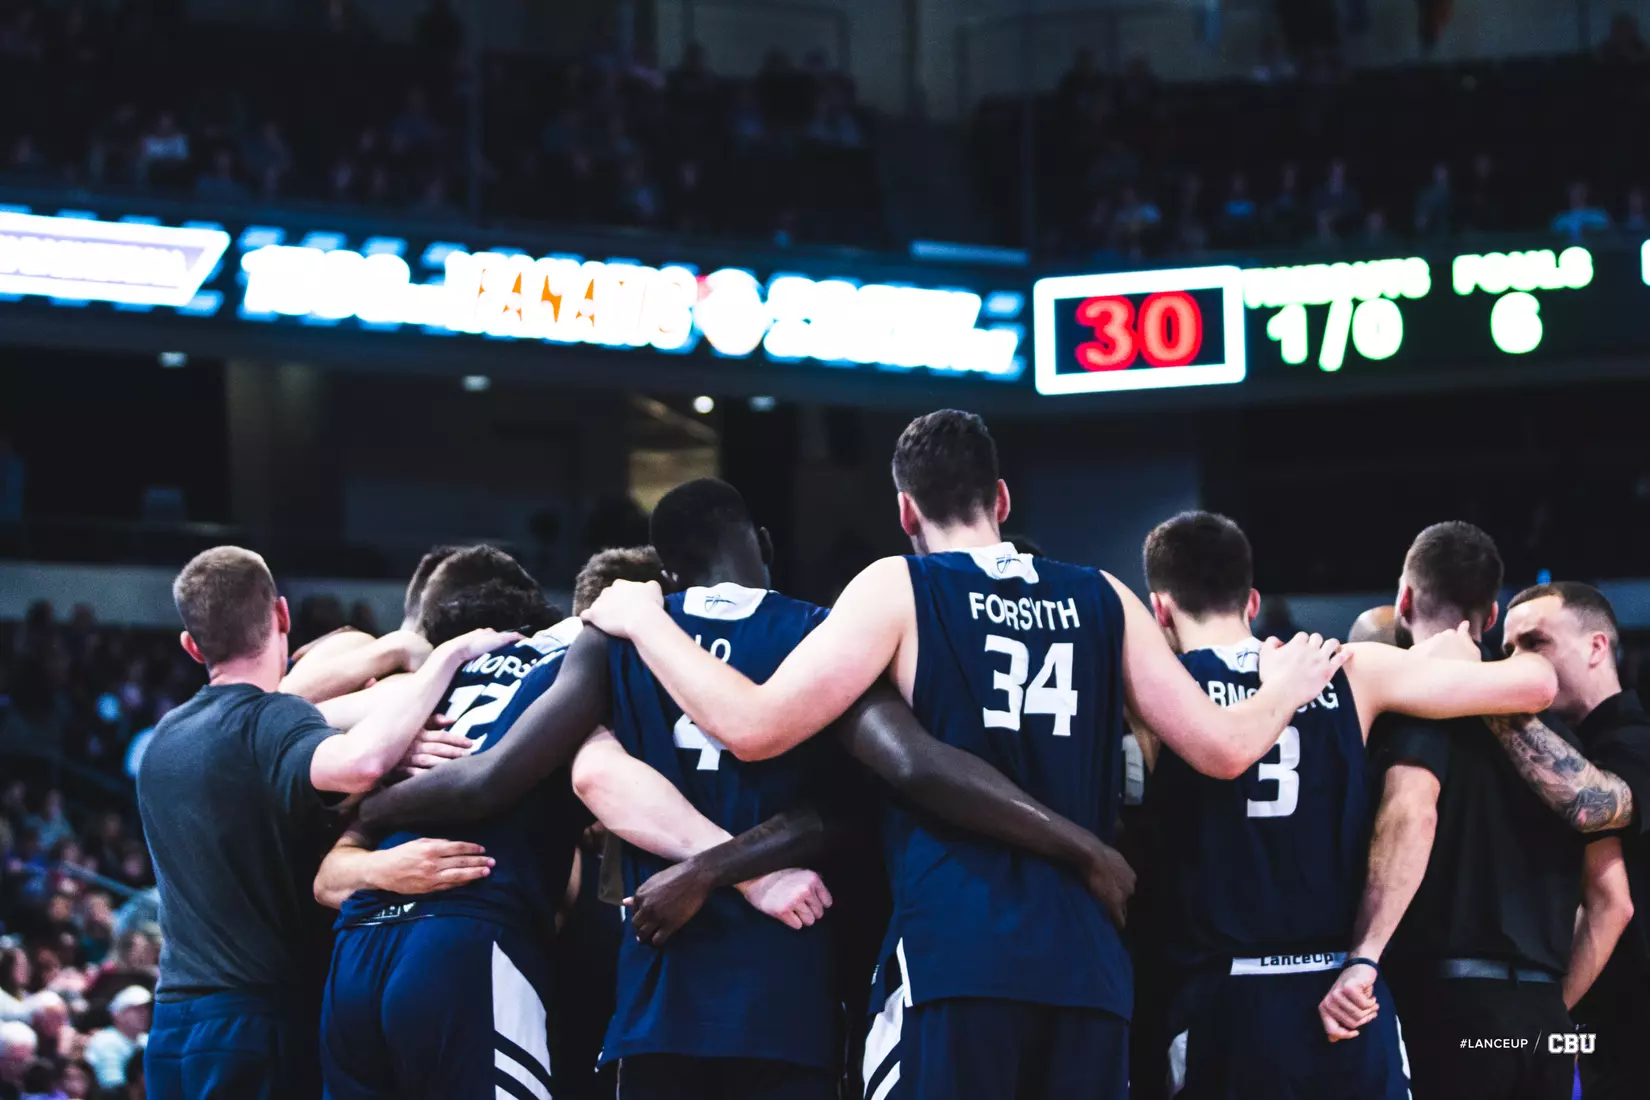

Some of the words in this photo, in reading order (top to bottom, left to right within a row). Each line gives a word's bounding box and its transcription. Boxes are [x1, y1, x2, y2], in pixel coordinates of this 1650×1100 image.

[1076, 290, 1202, 372] 30
[968, 591, 1081, 631] FORSYTH
[982, 634, 1079, 737] 34
[1246, 725, 1301, 818] 3
